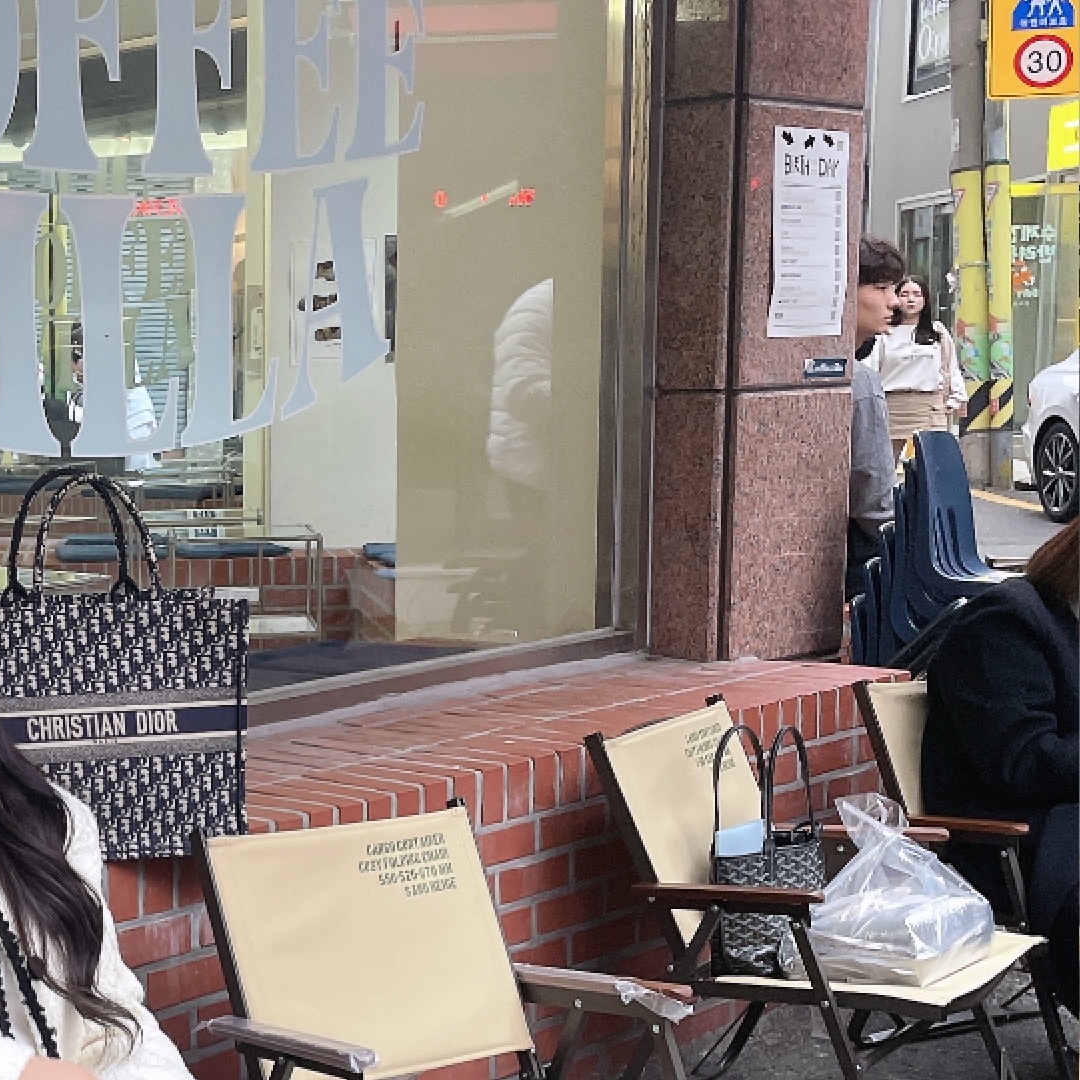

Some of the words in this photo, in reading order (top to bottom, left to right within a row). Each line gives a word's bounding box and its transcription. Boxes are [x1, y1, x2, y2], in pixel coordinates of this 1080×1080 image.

[1027, 50, 1063, 73] 30
[26, 711, 126, 741] CHRISTIAN
[136, 709, 179, 734] DIOR
